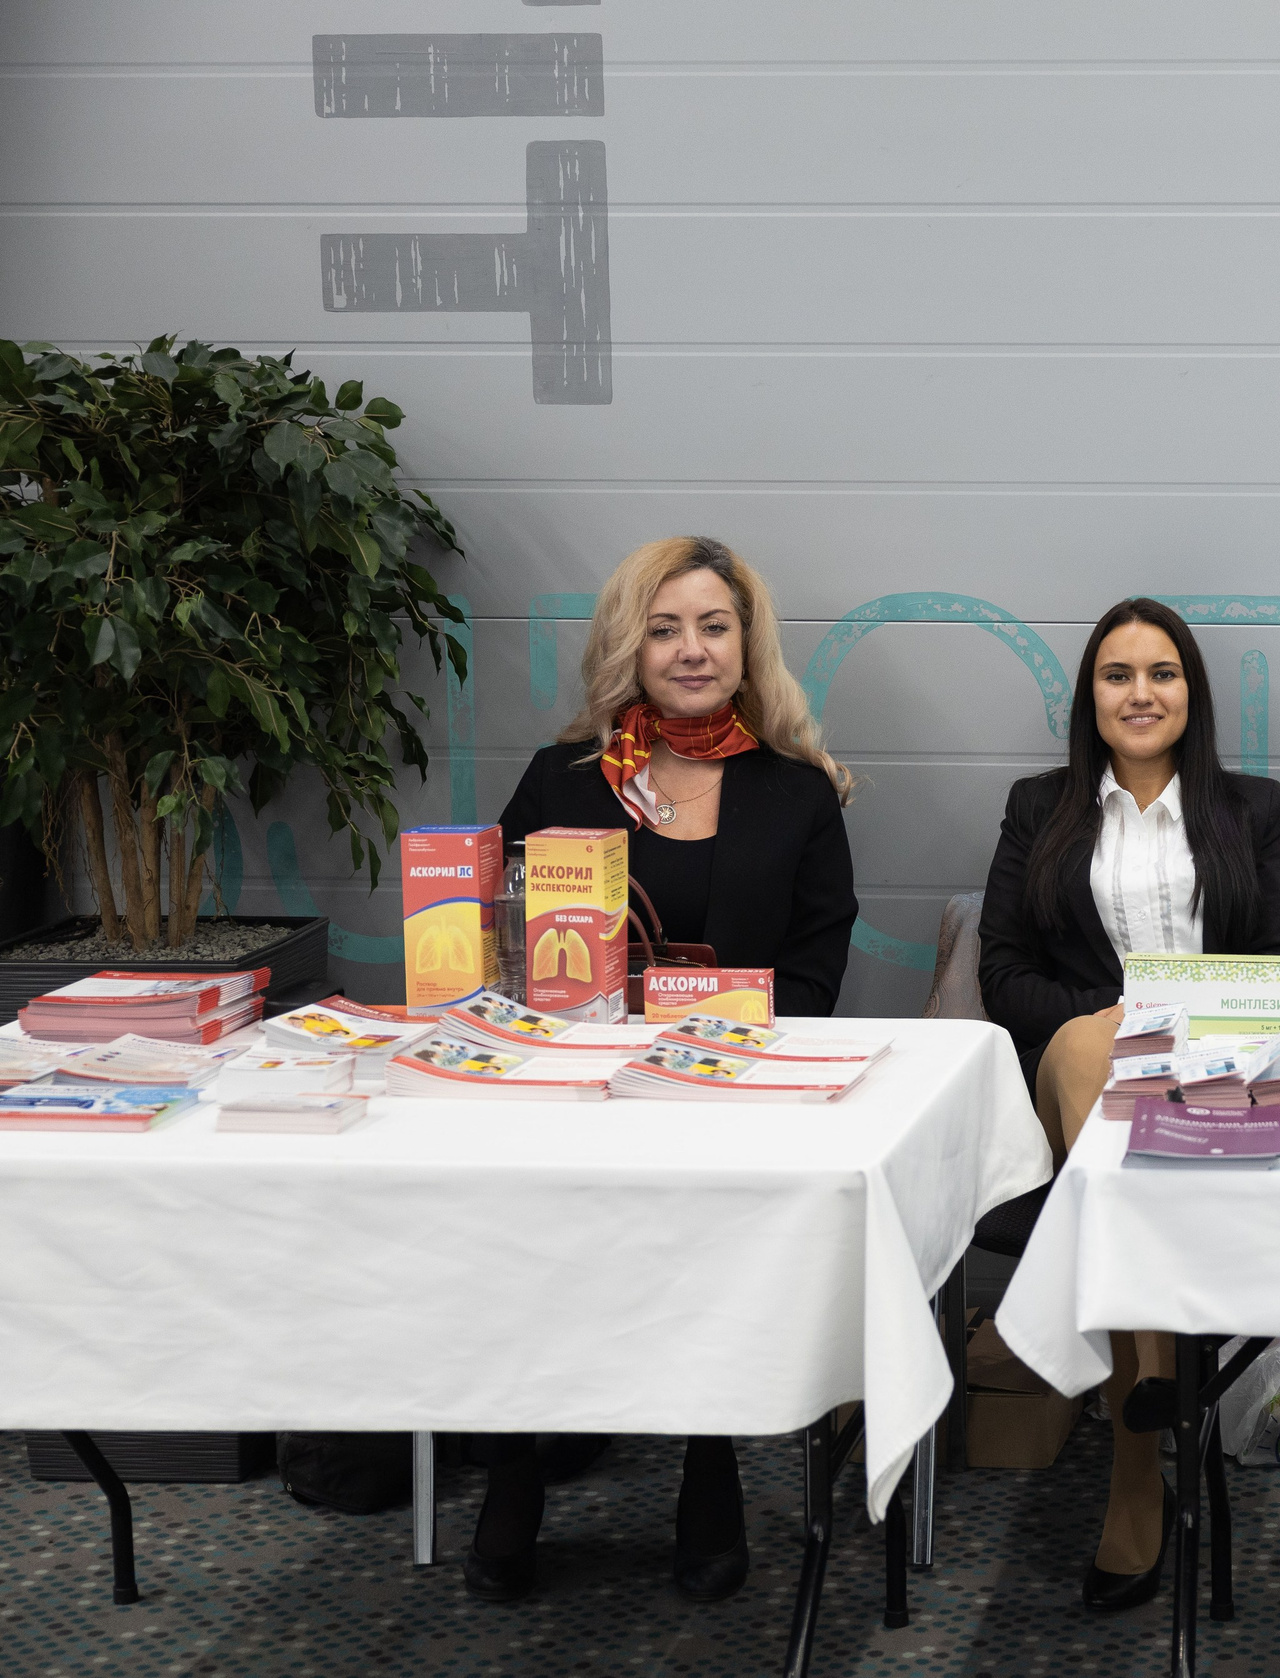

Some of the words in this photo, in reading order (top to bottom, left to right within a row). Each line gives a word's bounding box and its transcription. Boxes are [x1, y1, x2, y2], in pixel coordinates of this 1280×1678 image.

[410, 866, 455, 877] АСКОРИЛ
[459, 867, 472, 877] ЛС
[530, 865, 593, 880] АСКОРИЛ
[530, 882, 593, 893] ЭКСПЕКТОРАНТ
[555, 914, 567, 923] БЕЗ
[568, 915, 593, 923] САХАРА
[648, 976, 718, 992] АСКОРИЛ
